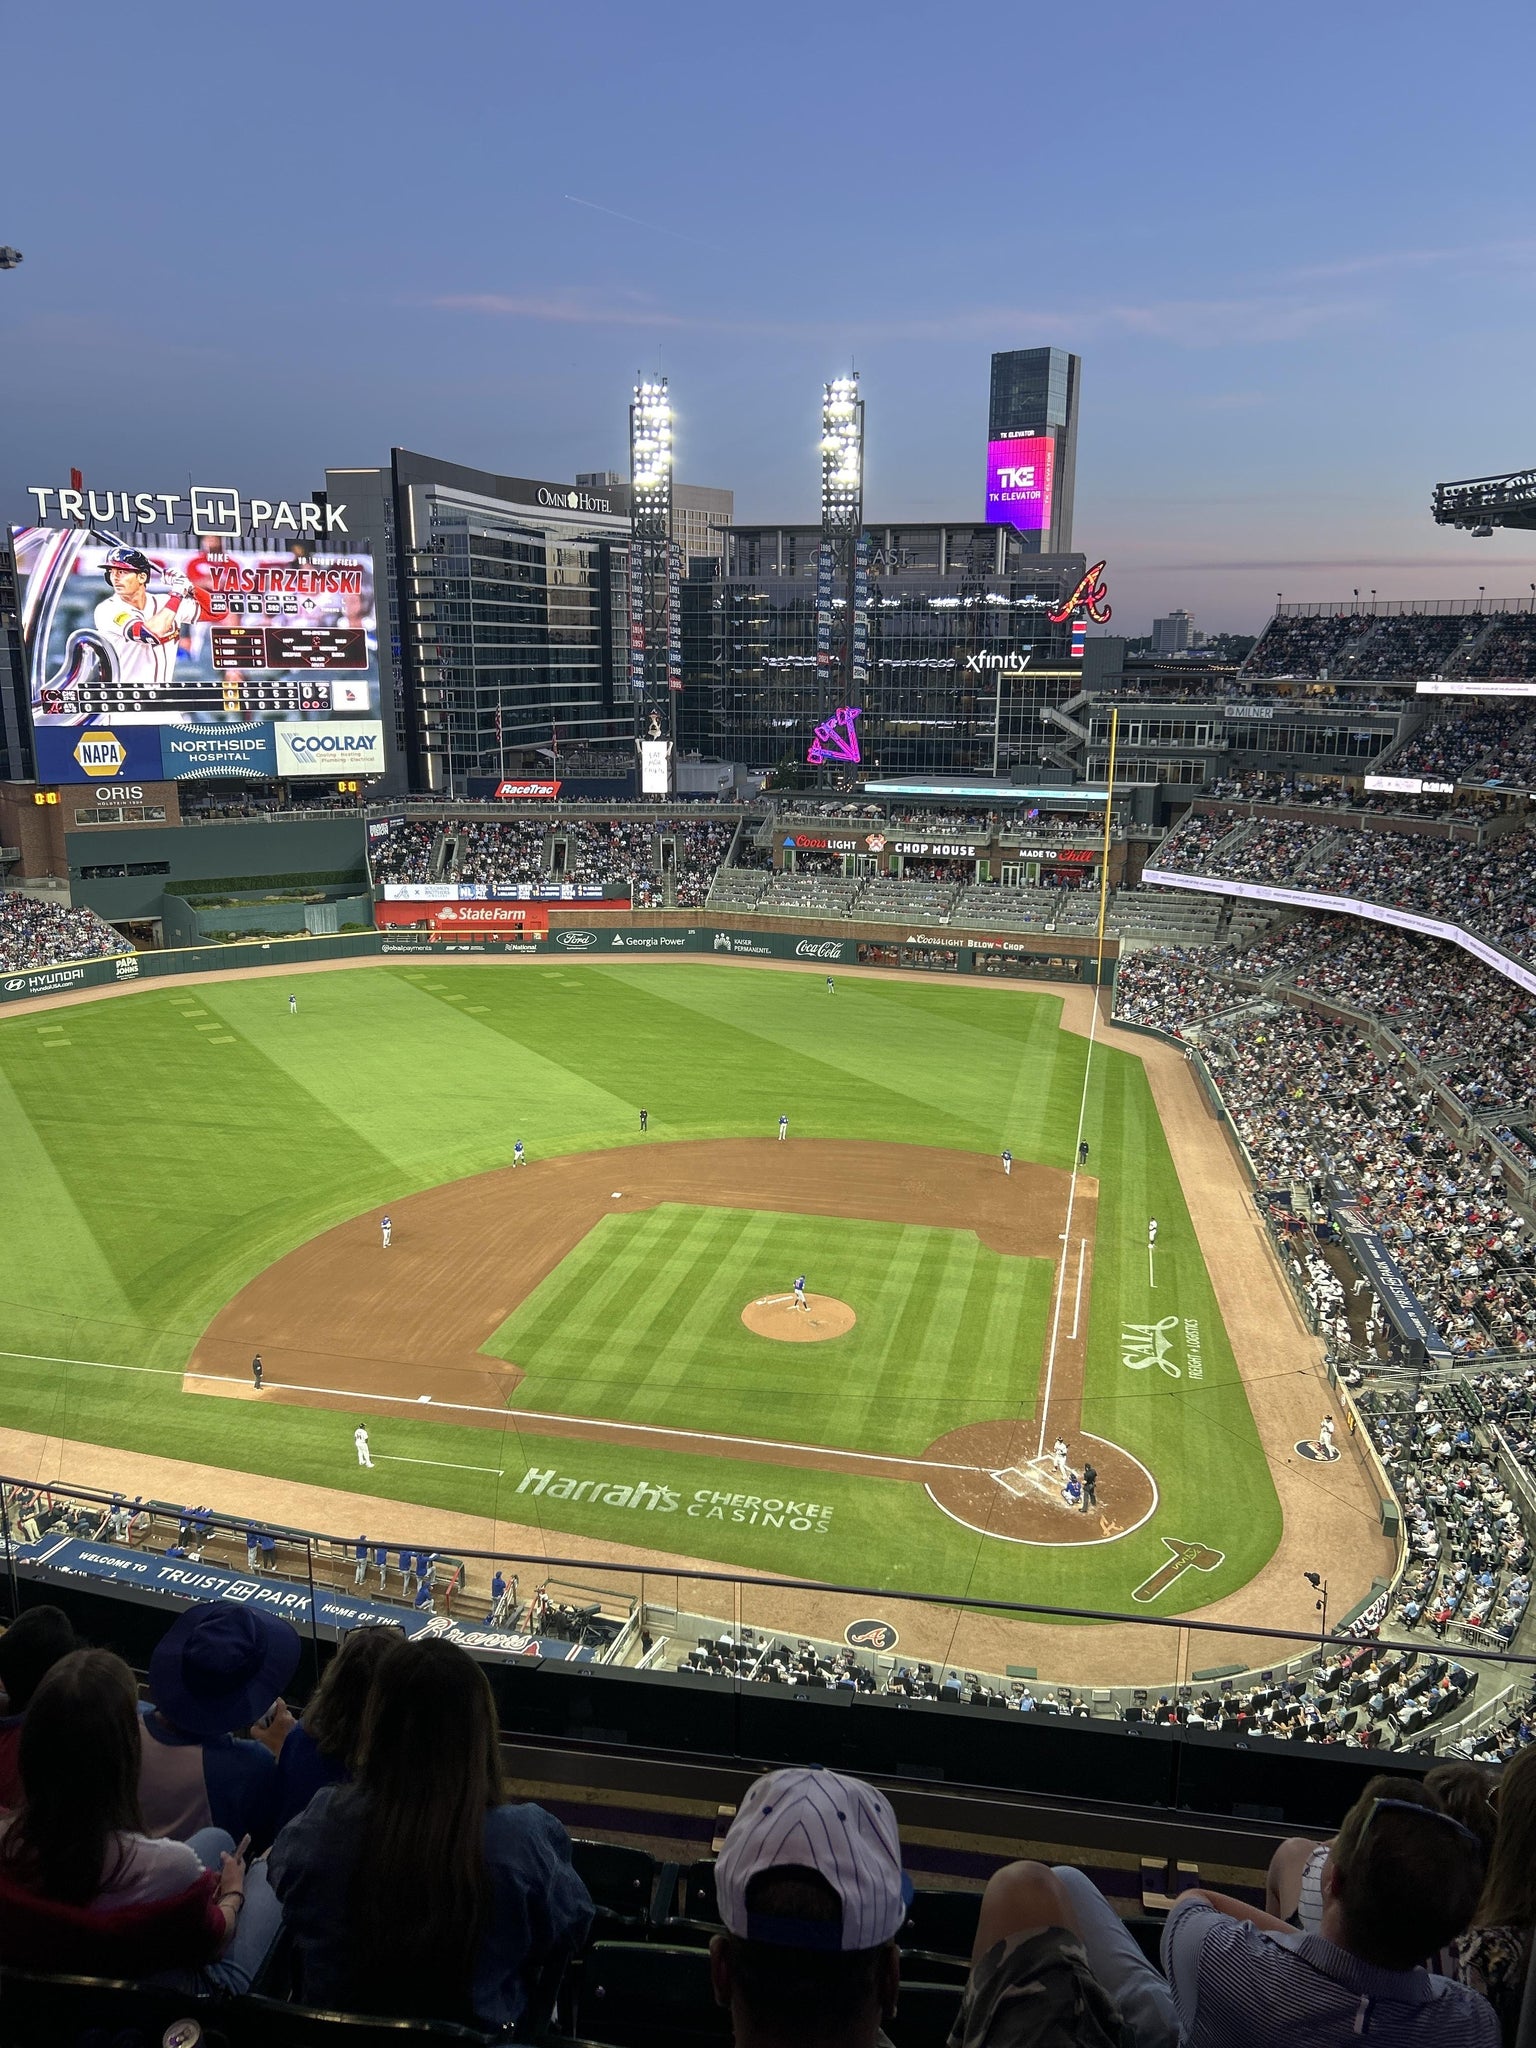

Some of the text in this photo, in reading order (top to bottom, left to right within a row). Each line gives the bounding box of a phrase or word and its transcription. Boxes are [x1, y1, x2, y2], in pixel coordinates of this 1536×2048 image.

[997, 466, 1034, 488] TKE
[989, 490, 1041, 502] TK ELEVATOR
[27, 486, 349, 534] TRUIST PARK
[207, 553, 229, 563] MIKE
[337, 558, 358, 567] FIELD
[209, 566, 362, 595] YASTRZEMSKI
[965, 649, 1031, 673] xfinity
[83, 691, 91, 700] 0
[100, 691, 108, 700] 0
[117, 691, 124, 700] 0
[133, 691, 140, 699] 0
[149, 690, 156, 699] 0
[227, 690, 234, 698] 0
[242, 690, 250, 698] 5
[258, 690, 264, 698] 0
[273, 690, 279, 698] 5
[287, 690, 295, 698] 2
[302, 687, 328, 699] 0 2
[84, 703, 92, 712] 0
[101, 703, 109, 712] 0
[117, 703, 125, 711] 0
[134, 703, 141, 711] 0
[228, 701, 235, 709] 0
[244, 701, 250, 709] 1
[258, 701, 265, 709] 0
[274, 701, 280, 709] 3
[288, 701, 296, 709] 2
[1235, 707, 1272, 719] MILNER
[170, 739, 267, 753] NORTHSIDE
[290, 735, 375, 753] COOLRAY
[83, 744, 119, 763] NAPA
[189, 752, 251, 762] HOSPITAL
[95, 785, 144, 801] ORIS
[500, 784, 554, 794] RaceTrac
[796, 834, 857, 850] Coors LIGHT
[894, 843, 976, 857] CHOP HOUSE
[1019, 849, 1095, 863] MADE TO Chill
[461, 886, 475, 897] NL
[563, 933, 590, 945] Ford
[625, 937, 686, 947] Georgia Power
[916, 934, 1025, 951] Coors LIGHT BELOW CHOP
[512, 943, 537, 951] National
[795, 939, 844, 959] Coca-Cola
[115, 965, 139, 976] JOHNS
[116, 957, 138, 969] PAPA
[28, 968, 84, 988] HYUNDAI
[29, 981, 74, 994] HyundaiUSA.com
[1374, 1260, 1414, 1309] TRUIST PARK
[1184, 1318, 1203, 1380] FREIGHT LOGISTICS
[693, 1489, 835, 1520] CHEROKEE
[686, 1504, 831, 1534] CASINOS
[78, 1551, 148, 1573] WELCOME TO
[156, 1566, 312, 1610] TRUIST PARK
[321, 1603, 401, 1627] HOME OF THE
[408, 1616, 532, 1650] Braves
